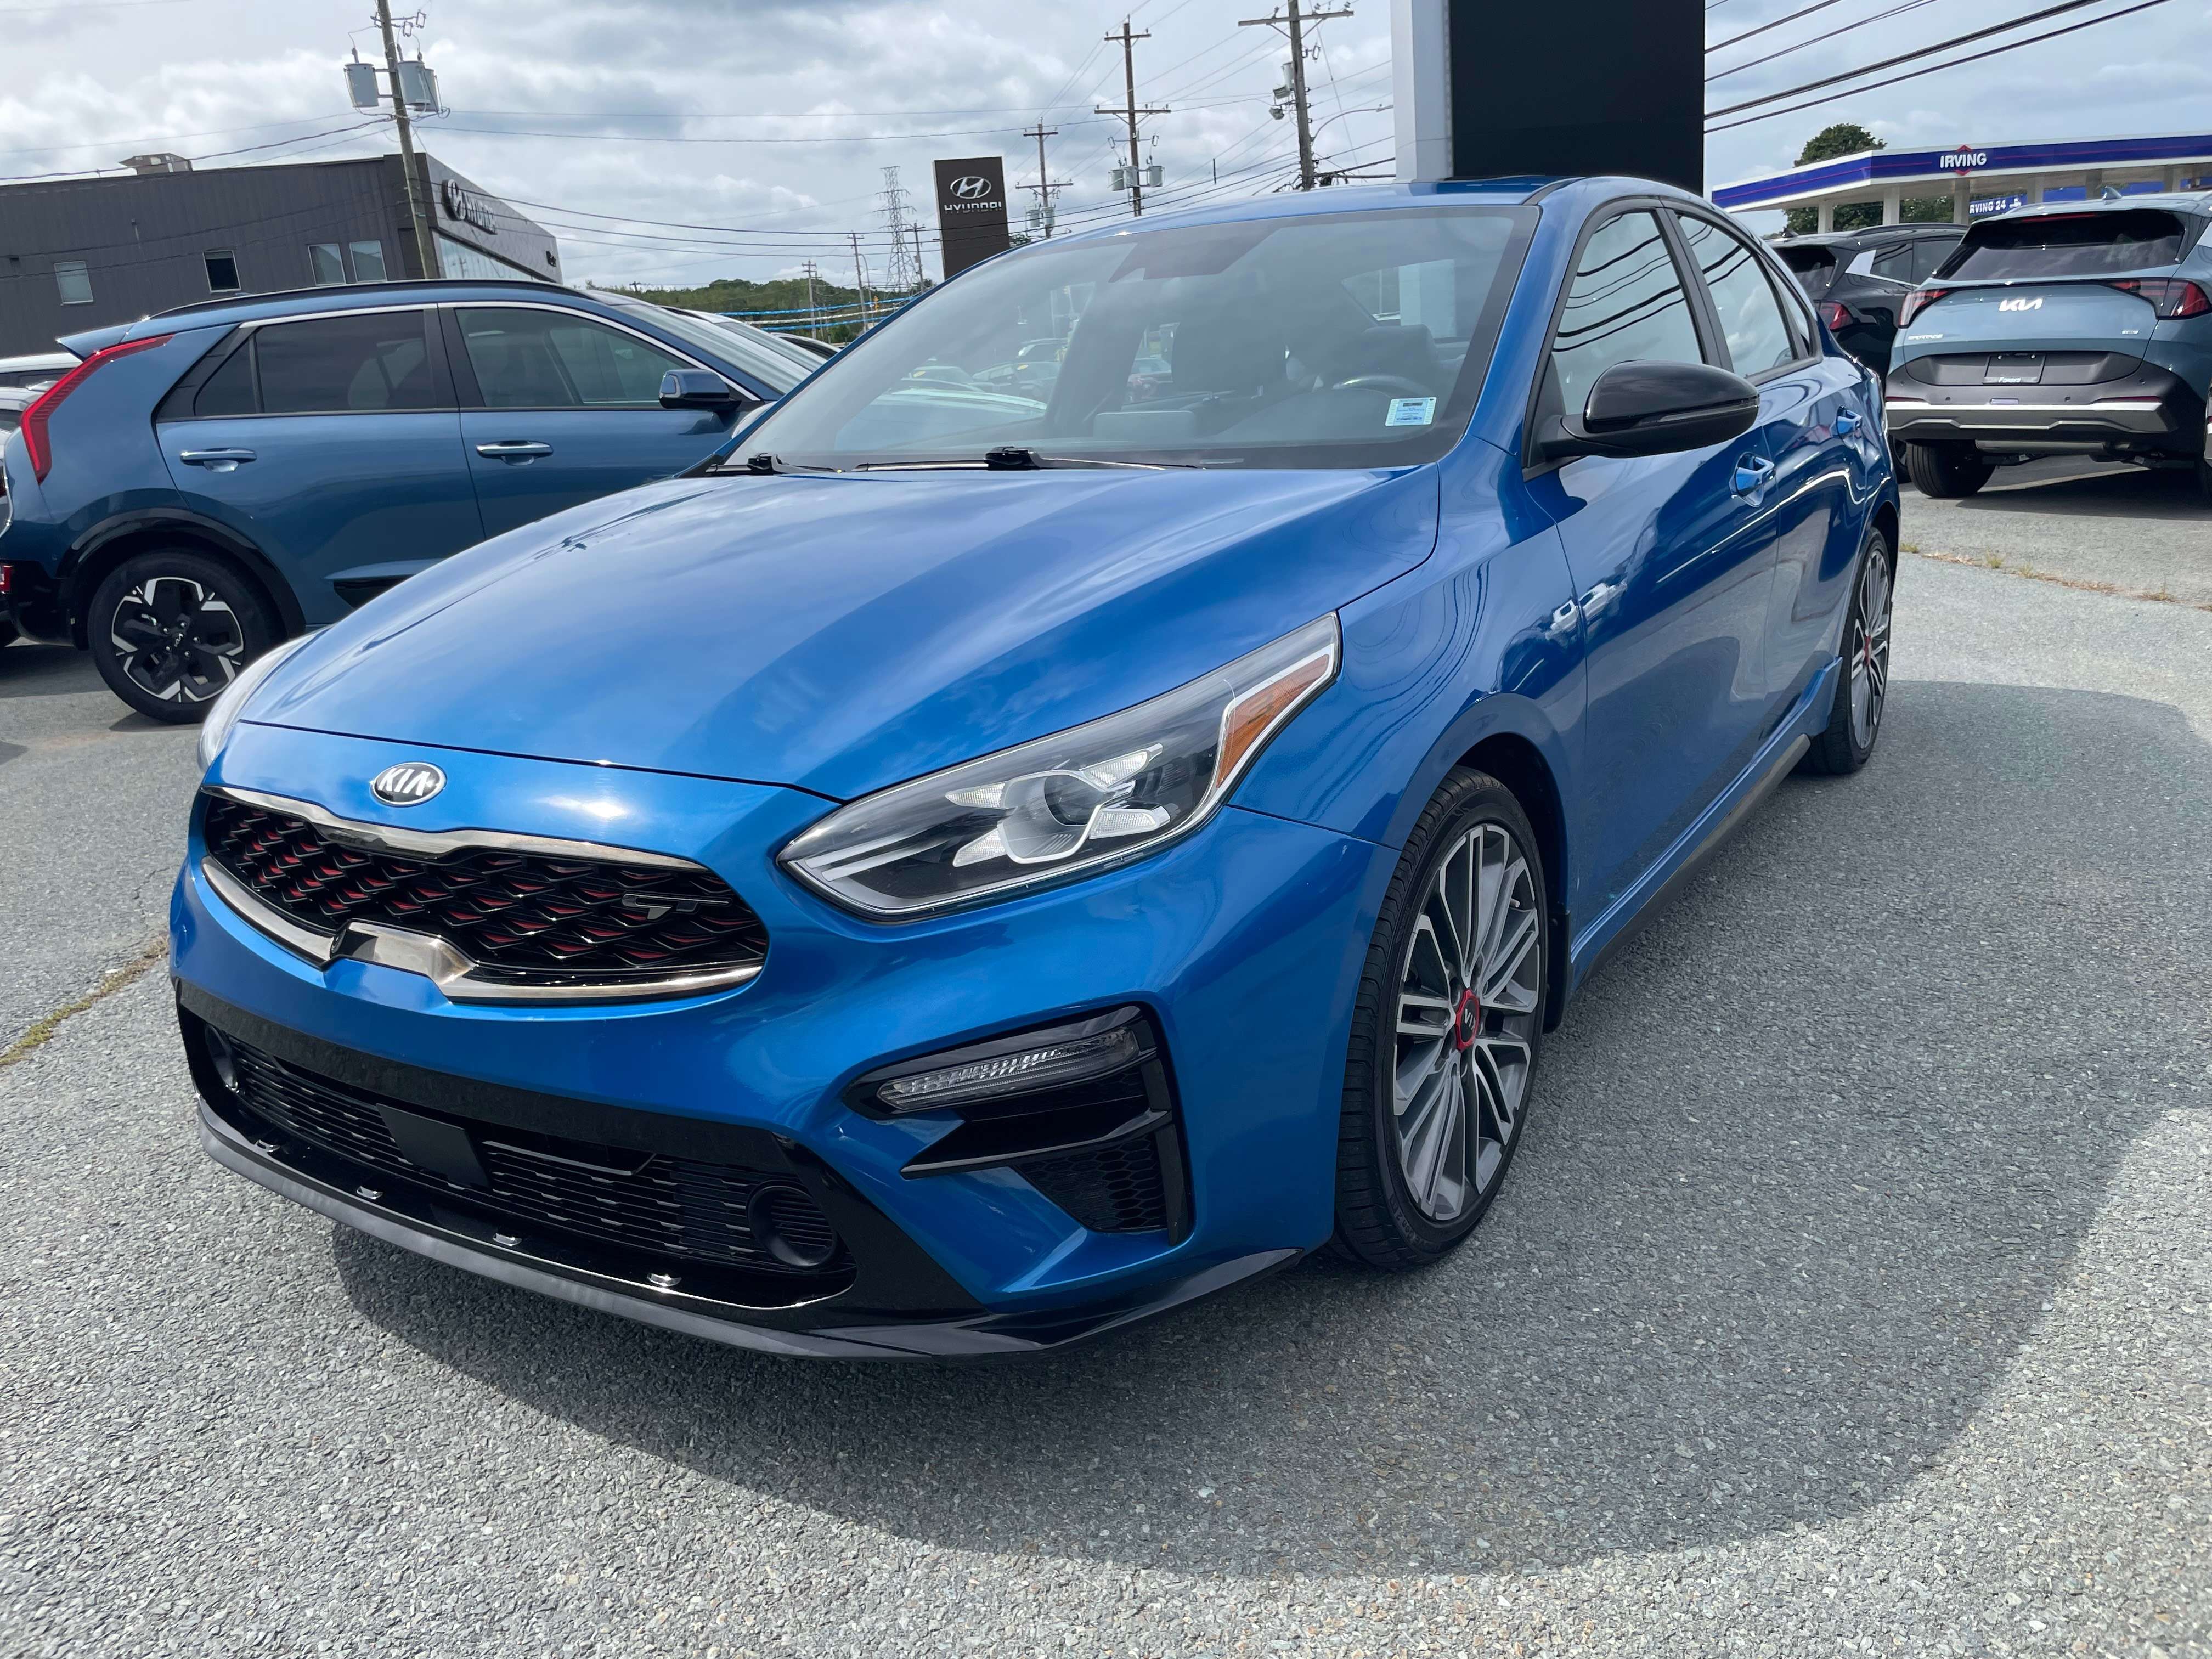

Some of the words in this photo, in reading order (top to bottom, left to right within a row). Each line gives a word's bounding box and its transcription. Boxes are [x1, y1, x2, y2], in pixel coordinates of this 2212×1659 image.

[1940, 153, 1987, 168] IRVING
[944, 201, 1002, 214] HYUNDAI
[1969, 201, 1994, 214] RVING
[1995, 200, 2006, 211] 24
[377, 768, 431, 796] KIA
